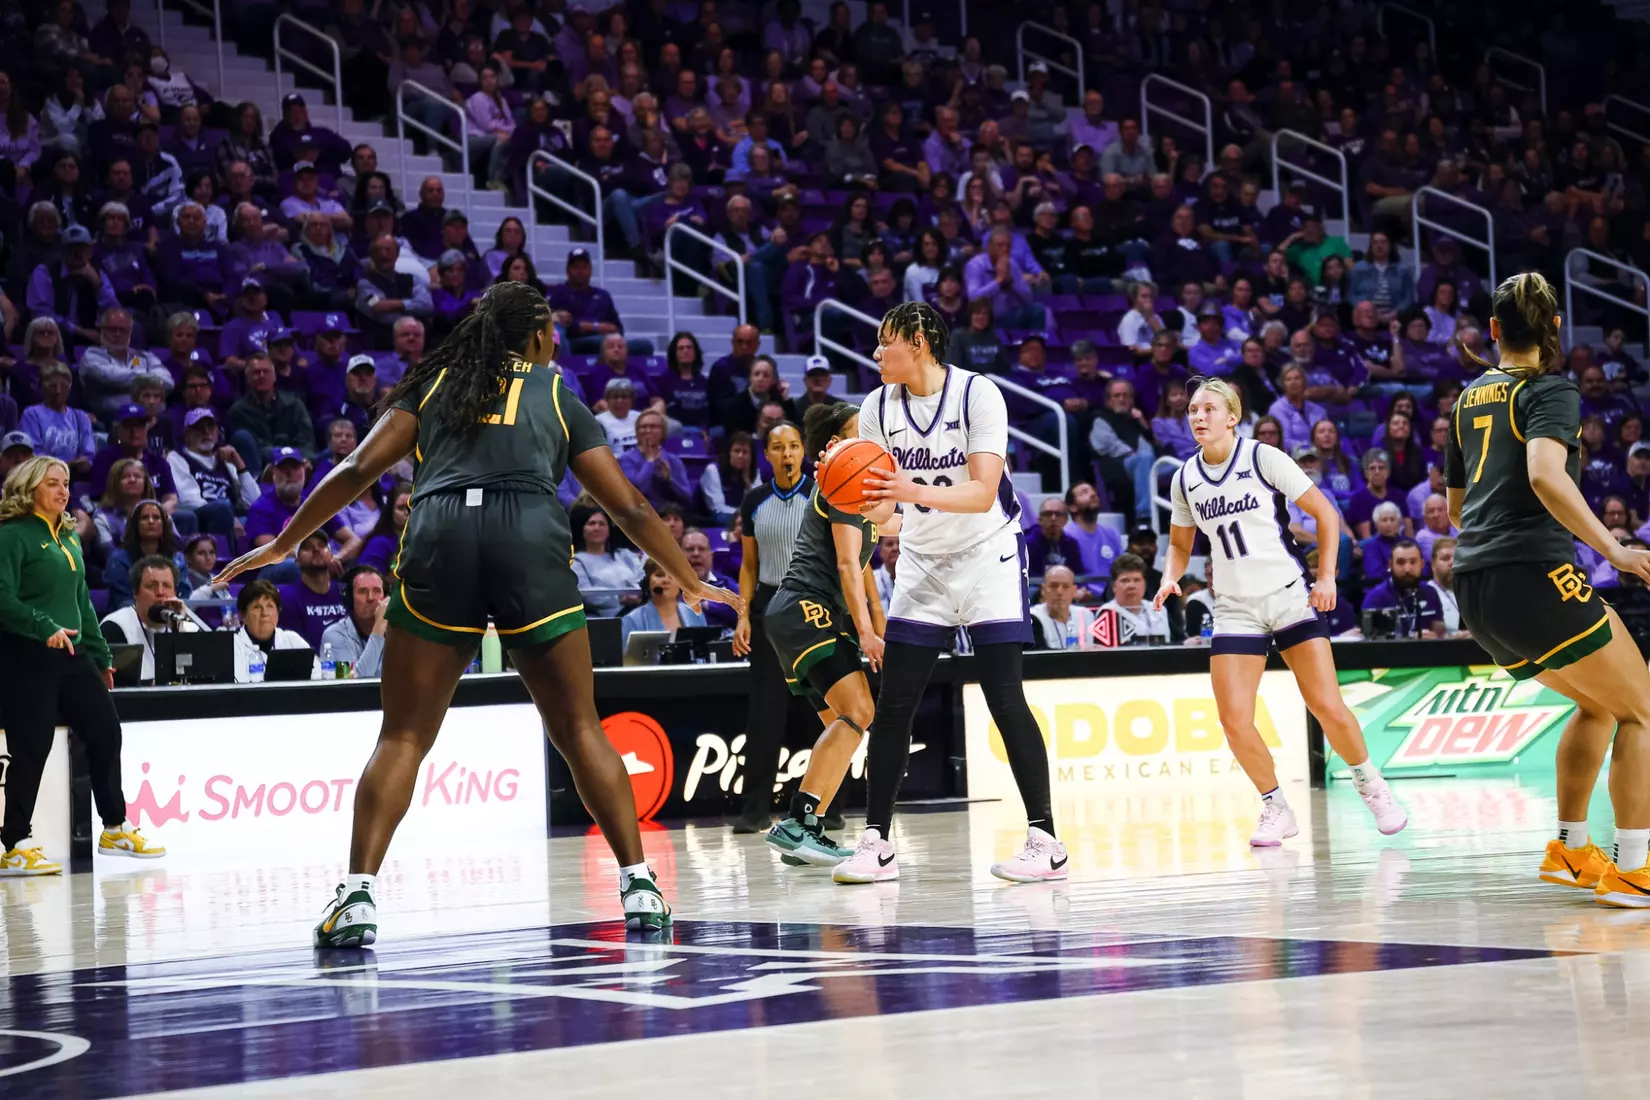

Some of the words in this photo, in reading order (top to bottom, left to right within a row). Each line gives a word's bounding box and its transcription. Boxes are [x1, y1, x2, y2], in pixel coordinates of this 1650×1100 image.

[1463, 382, 1510, 409] JENNINGS
[892, 446, 968, 470] Wildcats
[1473, 414, 1493, 484] 7
[1194, 492, 1260, 521] Wildcats
[1216, 520, 1249, 560] 11
[1413, 683, 1503, 716] Mtn
[1057, 760, 1193, 783] MEXICAN
[198, 774, 358, 821] SMOOT
